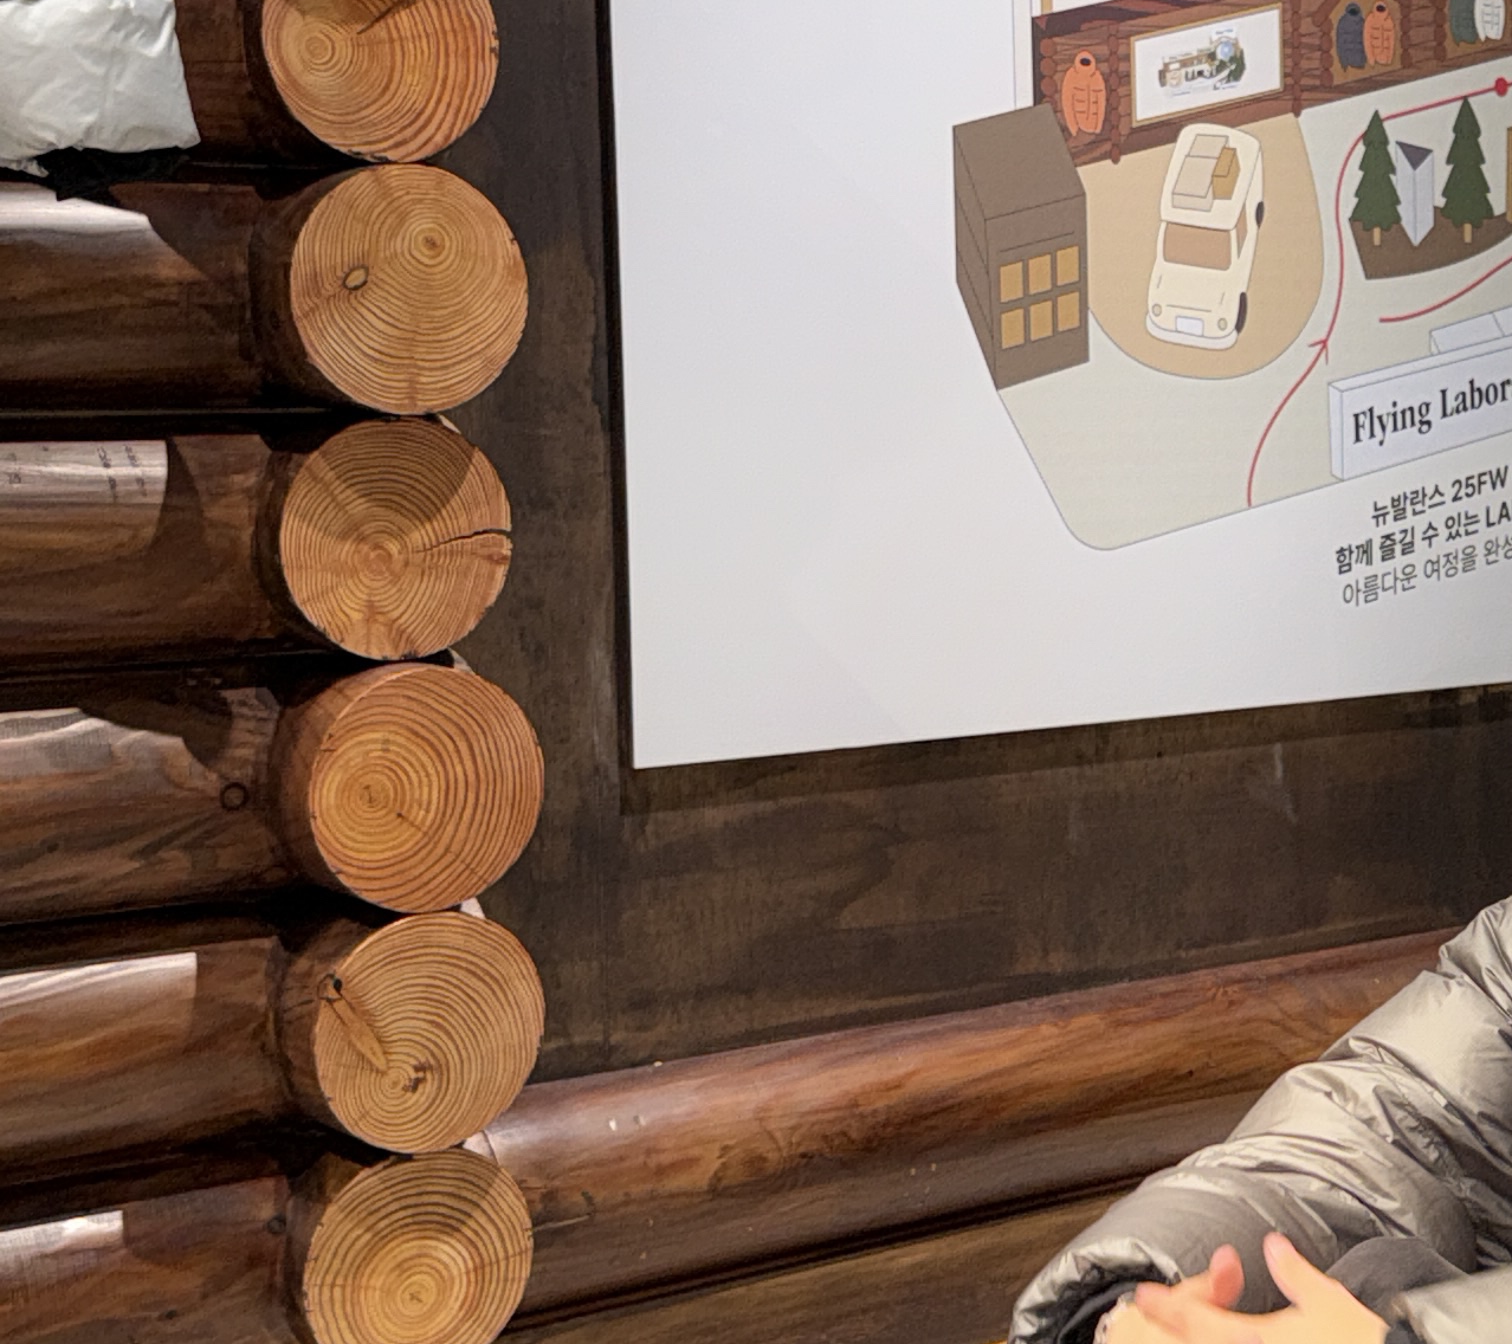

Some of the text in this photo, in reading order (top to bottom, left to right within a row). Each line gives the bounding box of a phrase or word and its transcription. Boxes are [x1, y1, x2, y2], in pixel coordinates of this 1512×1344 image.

[1352, 400, 1432, 447] Flying
[1372, 484, 1446, 528] 뉴발란스
[1451, 465, 1509, 503] 25FW
[1335, 538, 1373, 575] 함께
[1379, 526, 1416, 563] 즐길
[1421, 521, 1440, 549] 수
[1444, 510, 1481, 542] 있는
[1343, 563, 1417, 606] 아름다운
[1424, 545, 1478, 582] 여정을
